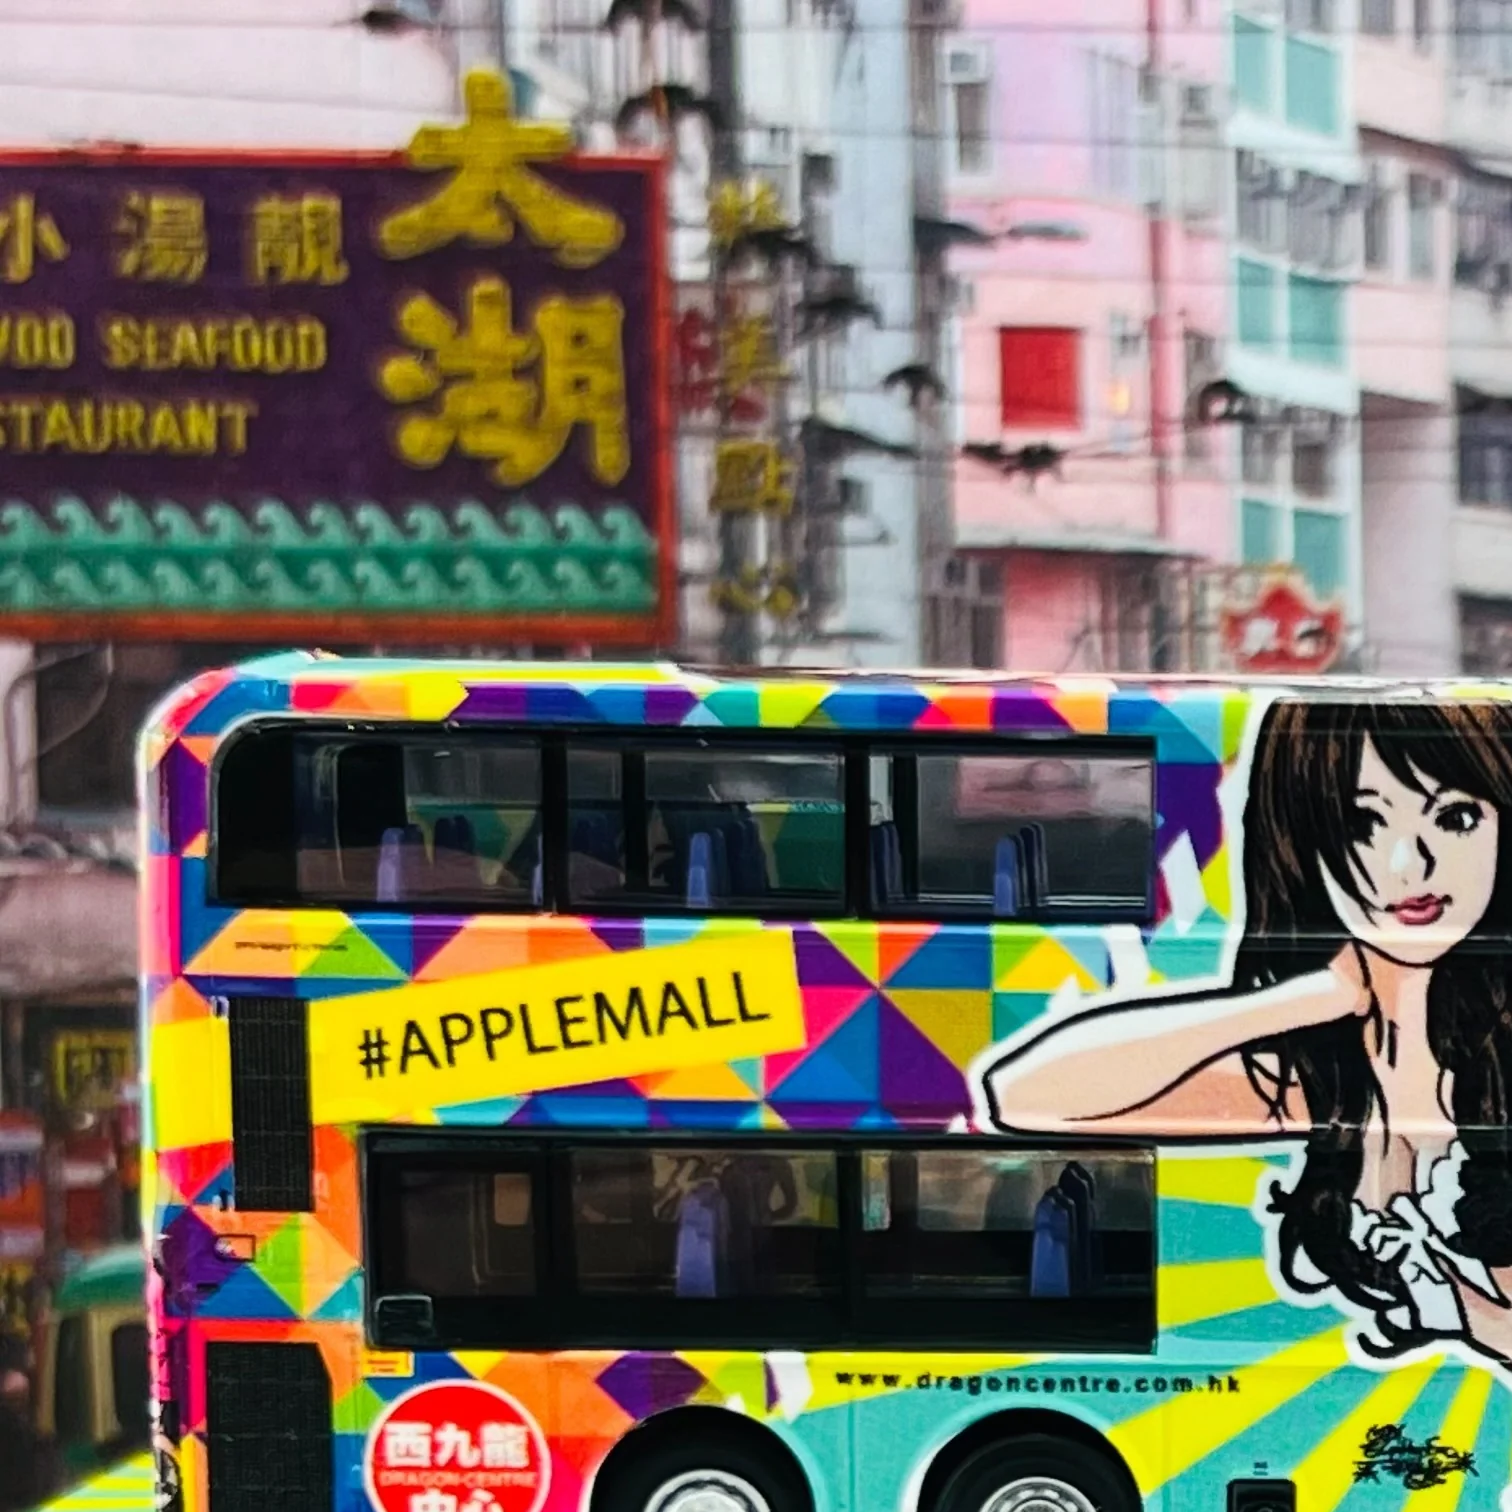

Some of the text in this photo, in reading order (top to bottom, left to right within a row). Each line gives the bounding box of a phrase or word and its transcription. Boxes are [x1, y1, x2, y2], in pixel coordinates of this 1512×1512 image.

[104, 314, 328, 373] SEAFOOD
[0, 398, 259, 455] TAURANT
[358, 971, 771, 1079] #APPLEMALL
[835, 1371, 1241, 1396] www.dragoncentre.com.hk
[385, 1421, 529, 1469] 西九龍
